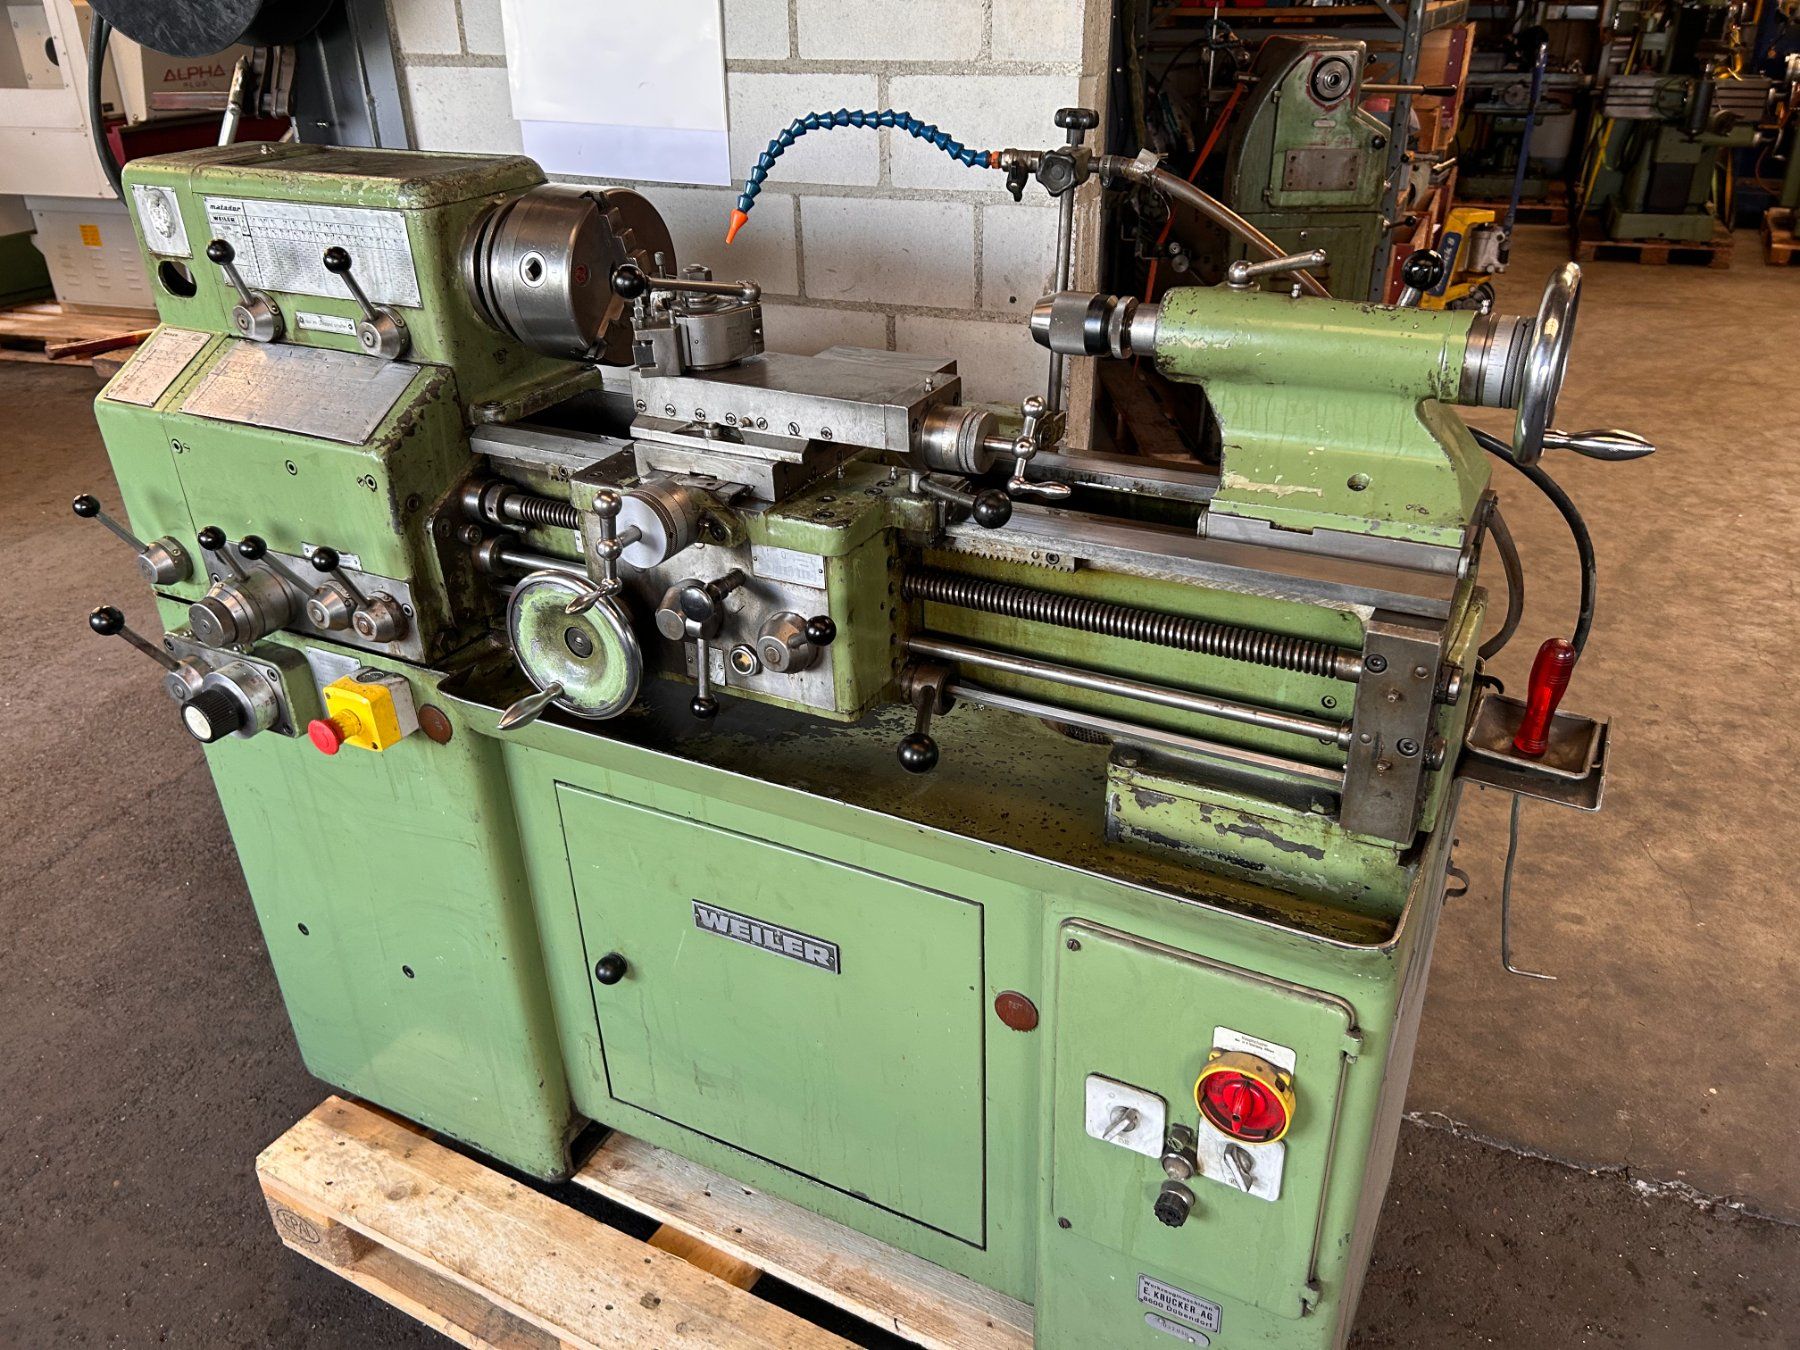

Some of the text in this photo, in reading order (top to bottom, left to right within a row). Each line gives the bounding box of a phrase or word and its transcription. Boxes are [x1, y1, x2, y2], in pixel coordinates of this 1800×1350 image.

[163, 64, 226, 82] ALPHA
[210, 204, 242, 212] matador
[697, 907, 830, 966] WEILER
[282, 1212, 315, 1241] EPAL
[1143, 1286, 1213, 1321] E. KRUCKER AG
